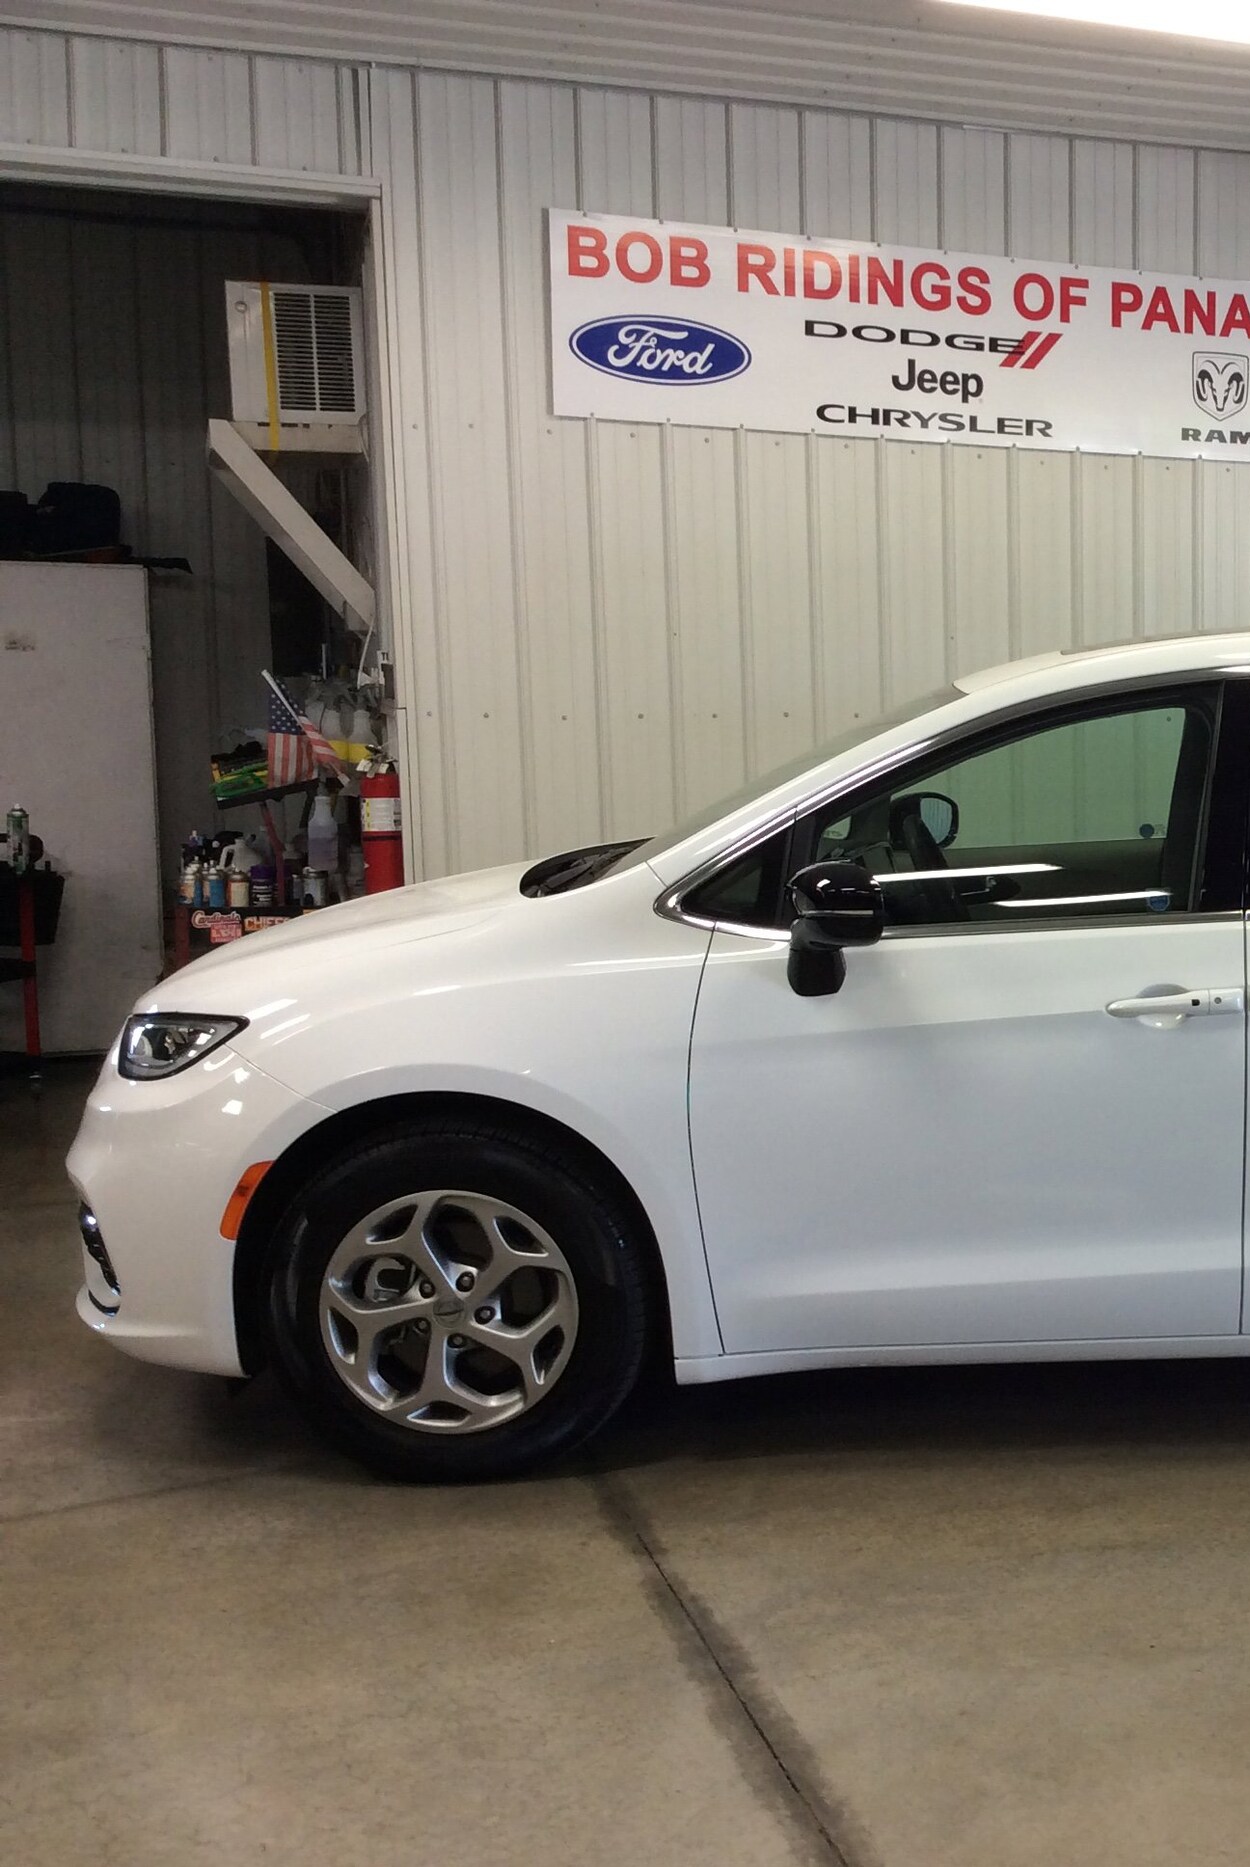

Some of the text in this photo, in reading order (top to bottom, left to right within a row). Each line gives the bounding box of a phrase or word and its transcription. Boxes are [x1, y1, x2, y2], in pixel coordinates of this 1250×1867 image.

[567, 225, 711, 288] BOB
[737, 243, 992, 316] RIDINGS
[1013, 273, 1089, 323] OF
[607, 324, 714, 375] Ford
[804, 320, 1026, 354] DODGE
[891, 358, 984, 404] Jeep
[816, 404, 1053, 438] CHRYSLER
